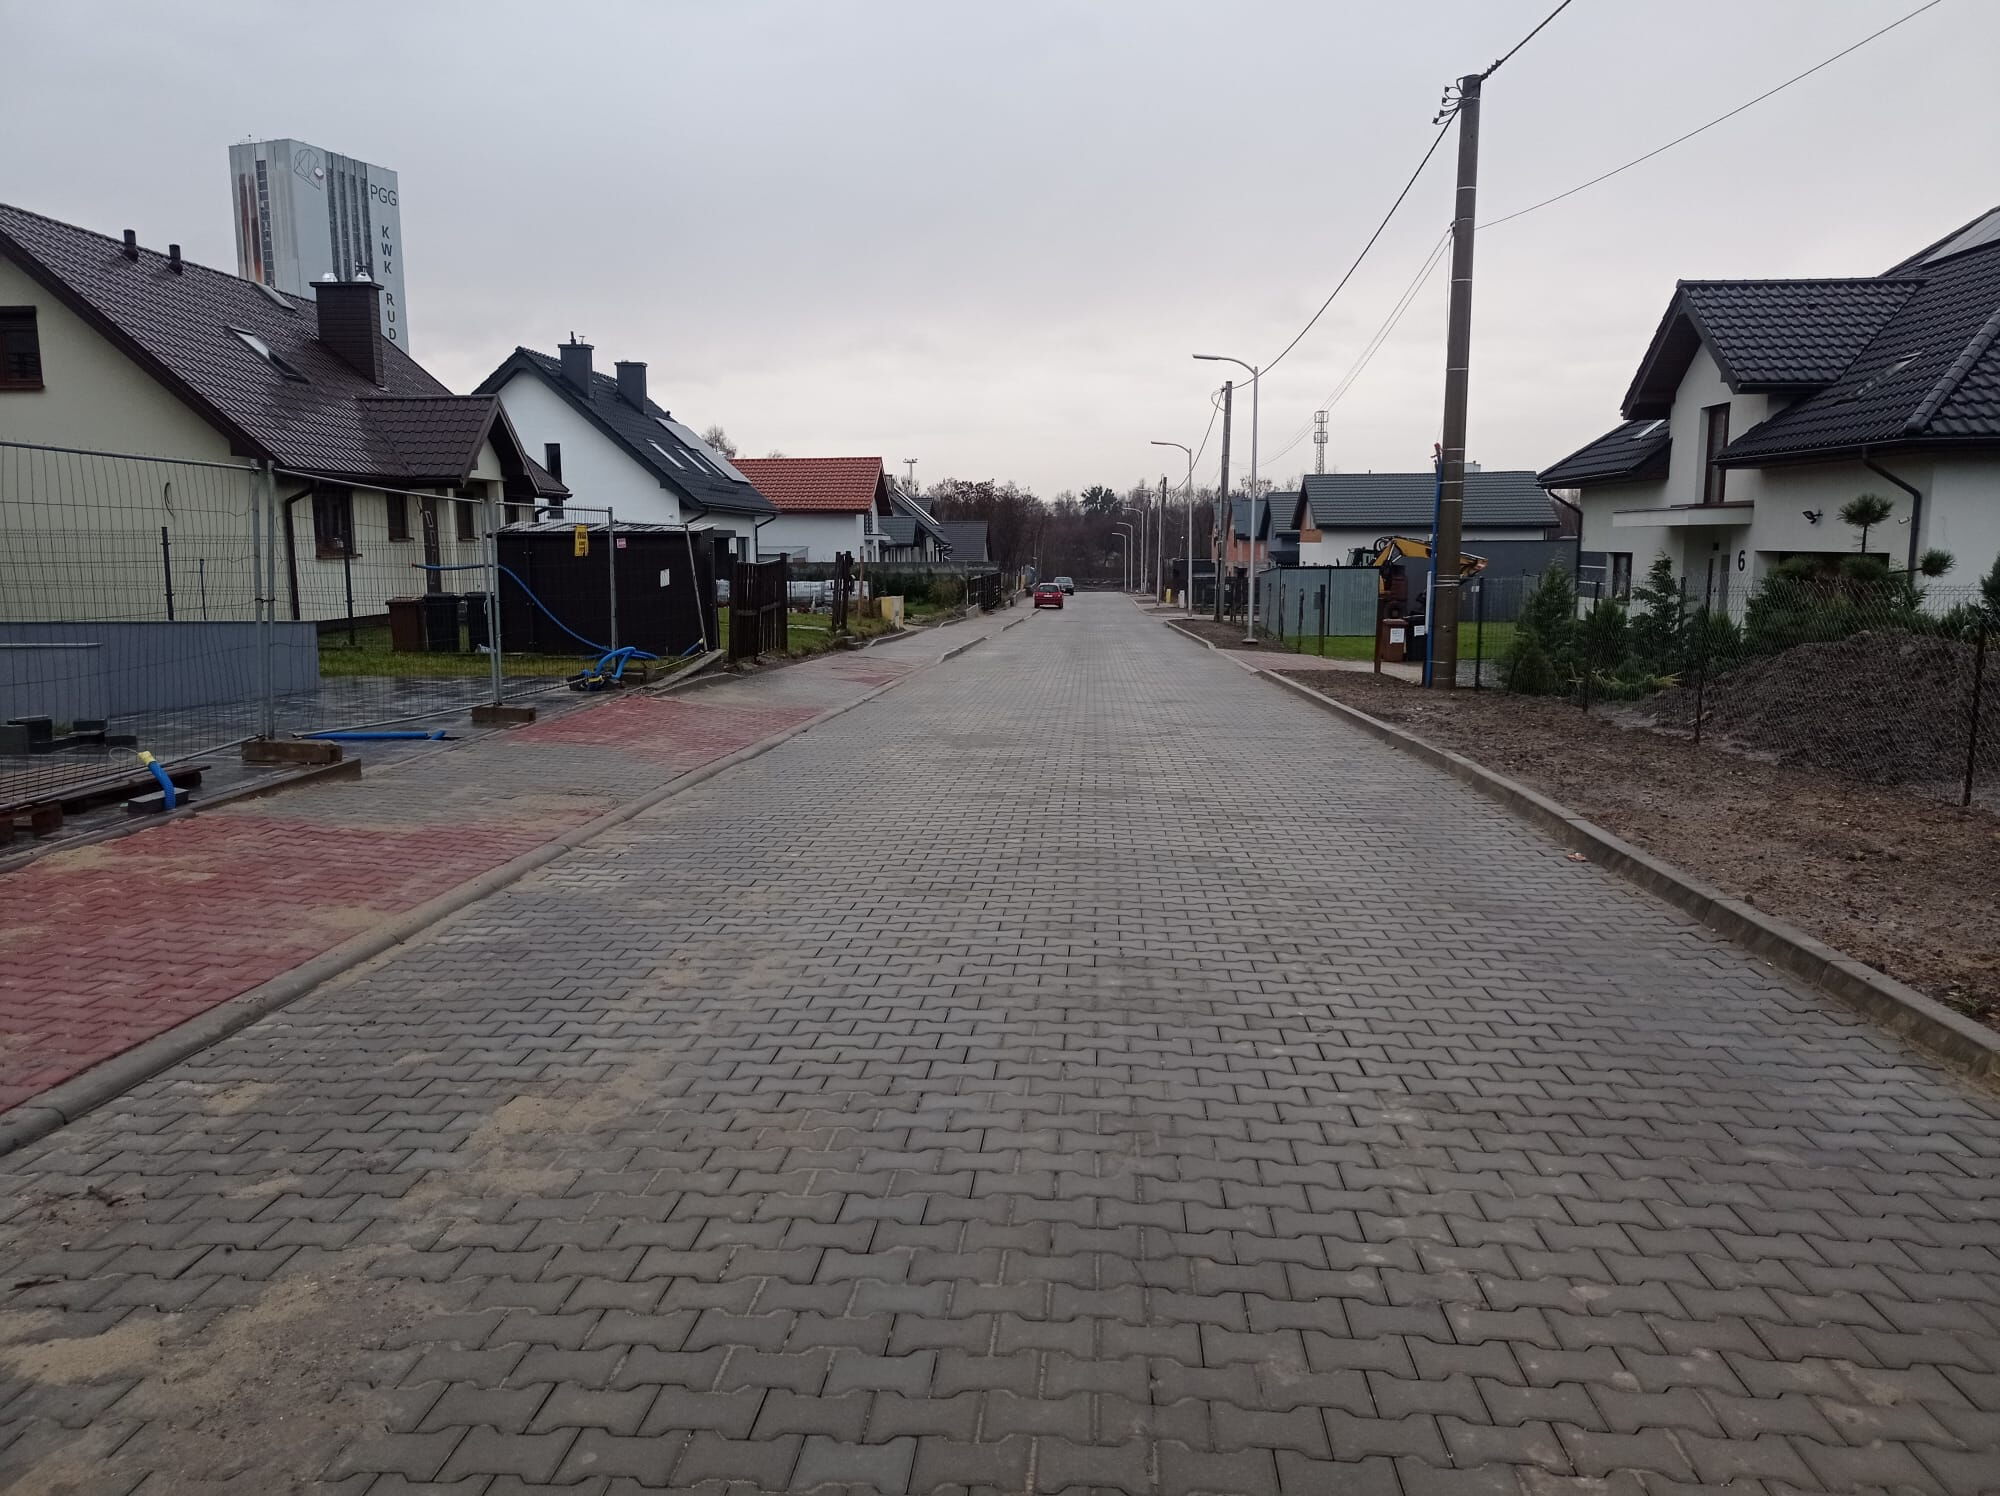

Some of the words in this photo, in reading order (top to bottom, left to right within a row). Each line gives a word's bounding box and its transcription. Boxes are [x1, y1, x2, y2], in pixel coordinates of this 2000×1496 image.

[370, 183, 397, 207] PGG
[381, 225, 392, 274] KWK
[1738, 550, 1745, 571] 6
